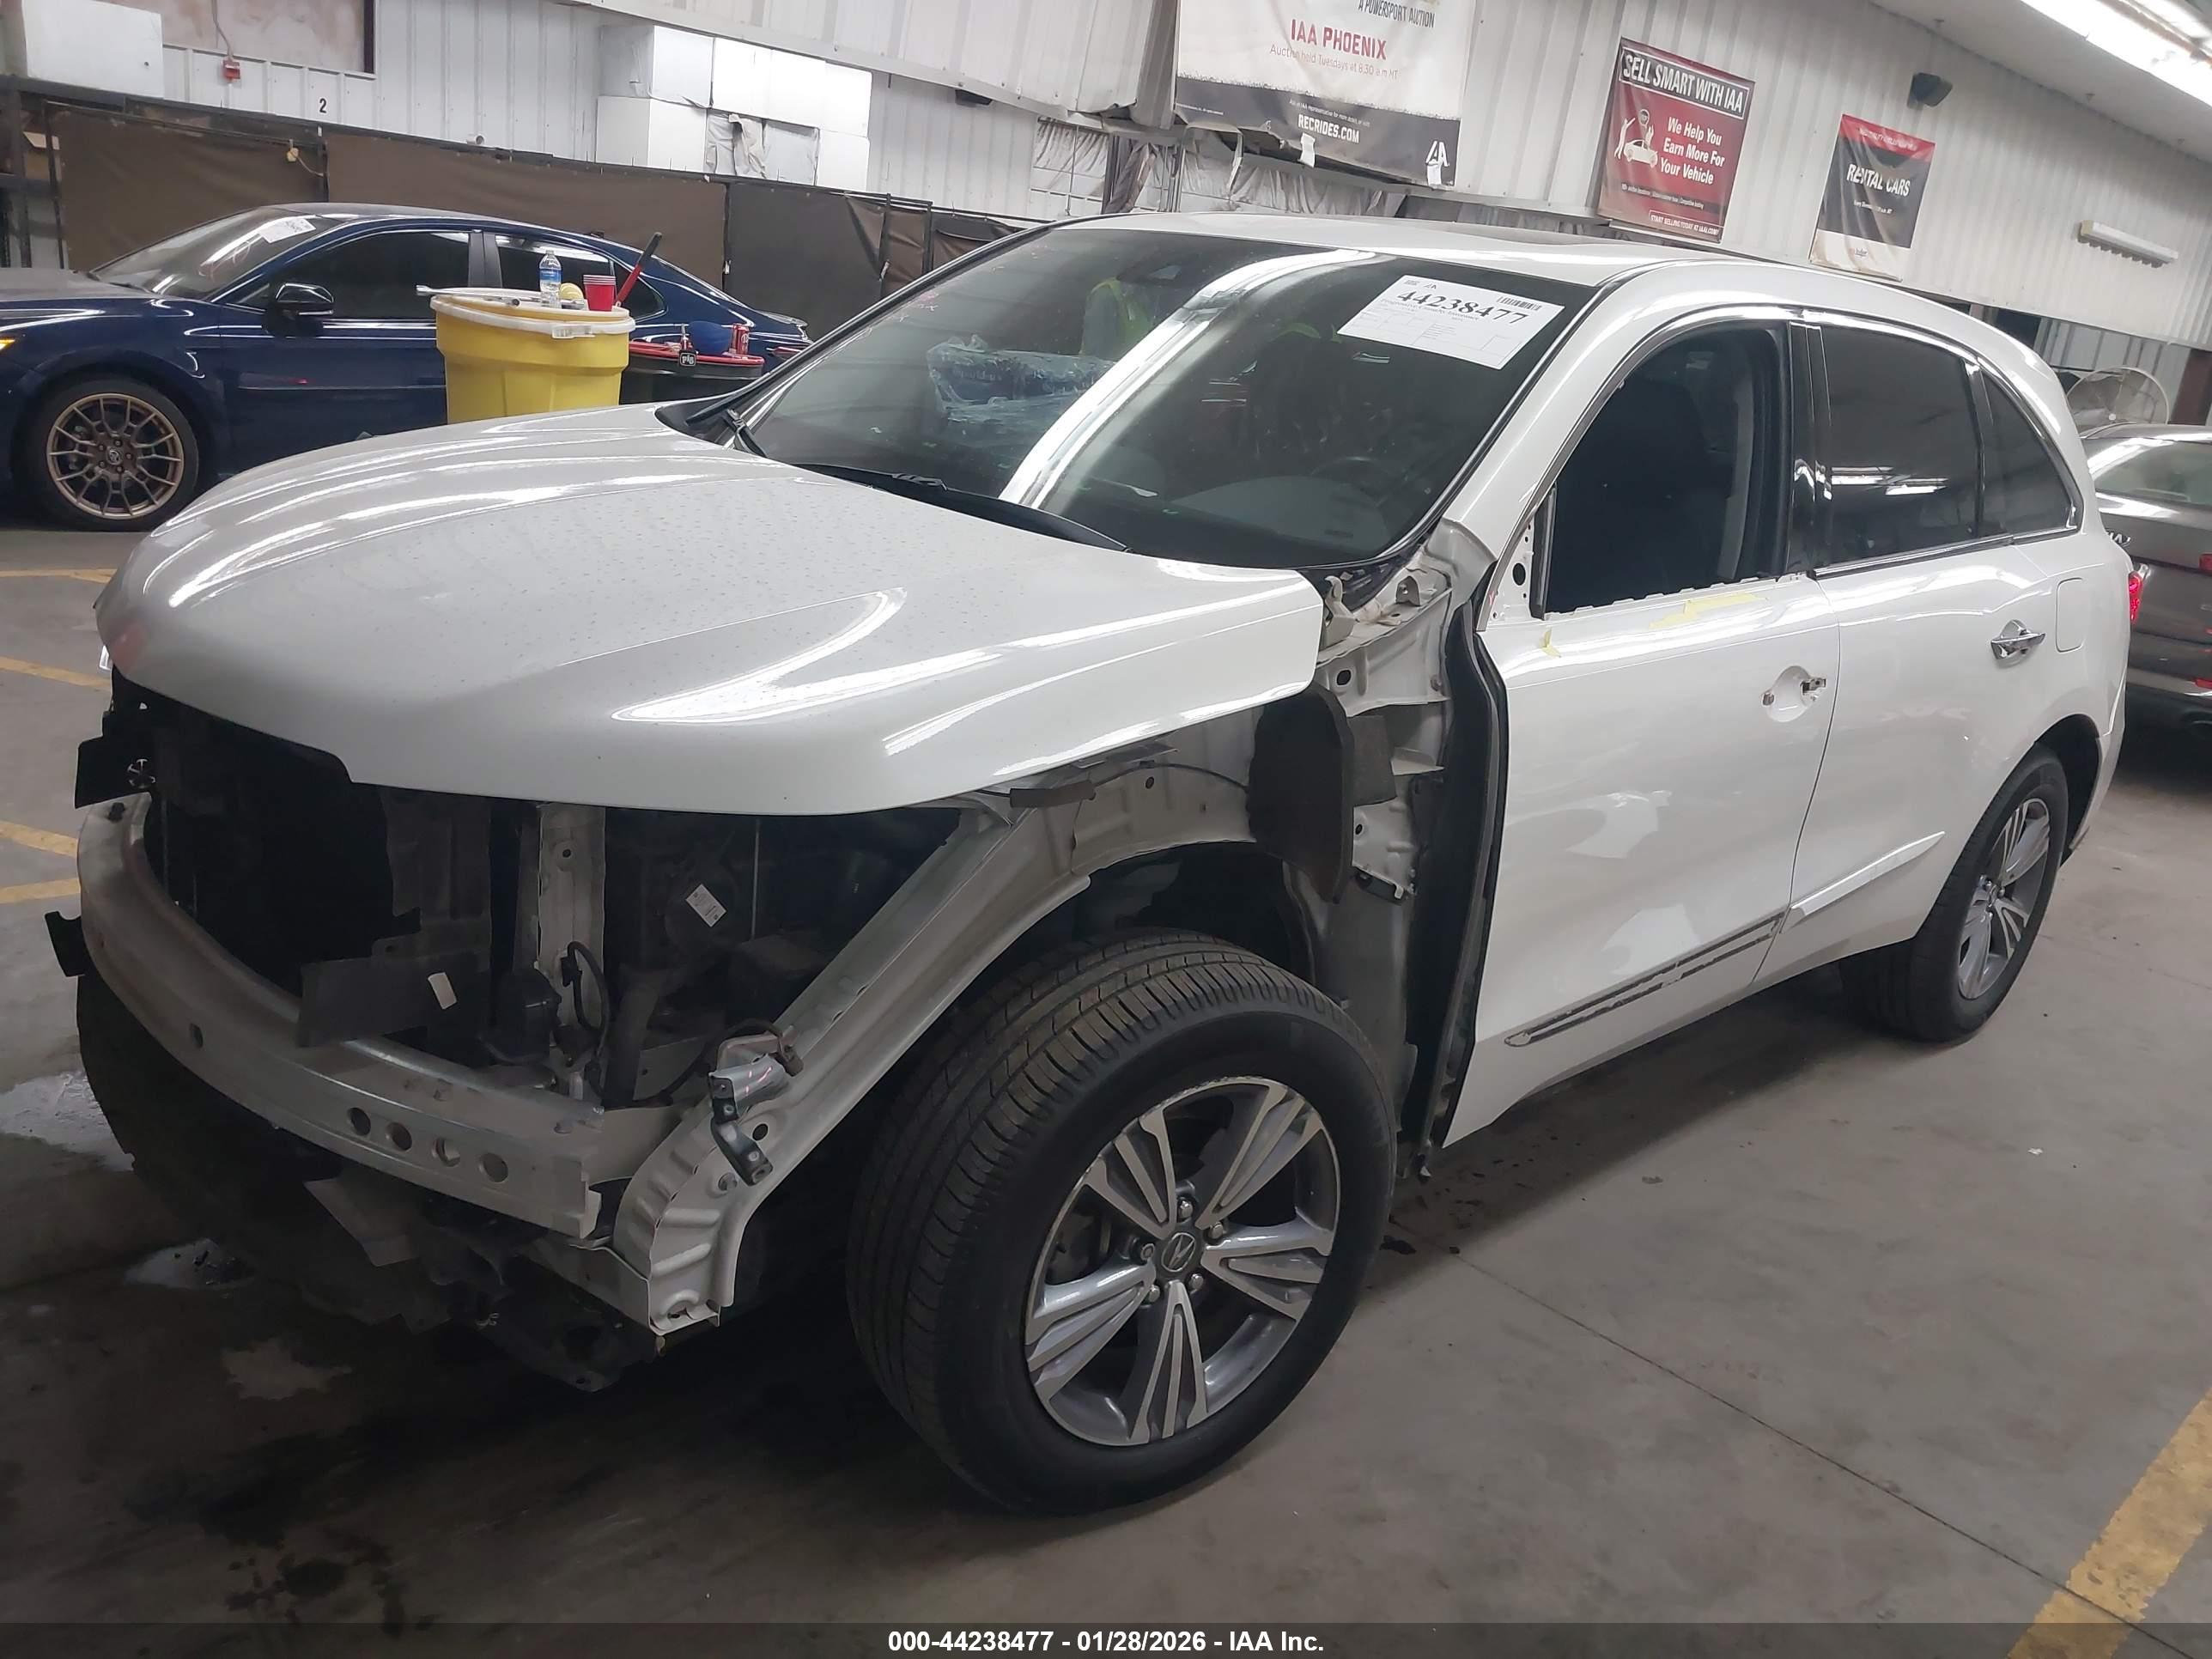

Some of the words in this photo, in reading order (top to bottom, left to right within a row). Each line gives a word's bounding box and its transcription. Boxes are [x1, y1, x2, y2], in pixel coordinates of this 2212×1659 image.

[1364, 0, 1407, 21] POWERSPORT
[1408, 7, 1435, 28] AUCTION
[1291, 19, 1317, 46] IAA
[1322, 27, 1387, 60] PHOENIX
[1318, 54, 1348, 71] Tuesdays
[1623, 54, 1650, 84] SELL
[1652, 64, 1695, 97] SMART
[1695, 77, 1725, 106] WITH
[1723, 87, 1743, 113] IAA
[319, 97, 327, 113] 2
[1298, 113, 1359, 143] RECRIDES.COM
[1668, 116, 1682, 135] We
[1683, 121, 1705, 144] Help
[1706, 127, 1723, 146] You
[1663, 137, 1685, 156] Earn
[1685, 143, 1709, 163] More
[1710, 150, 1725, 167] For
[1661, 156, 1680, 176] Your
[1682, 162, 1714, 185] Vehicle
[1846, 163, 1883, 190] RENTAL
[1886, 178, 1911, 197] CARS
[1397, 290, 1528, 325] 44238477
